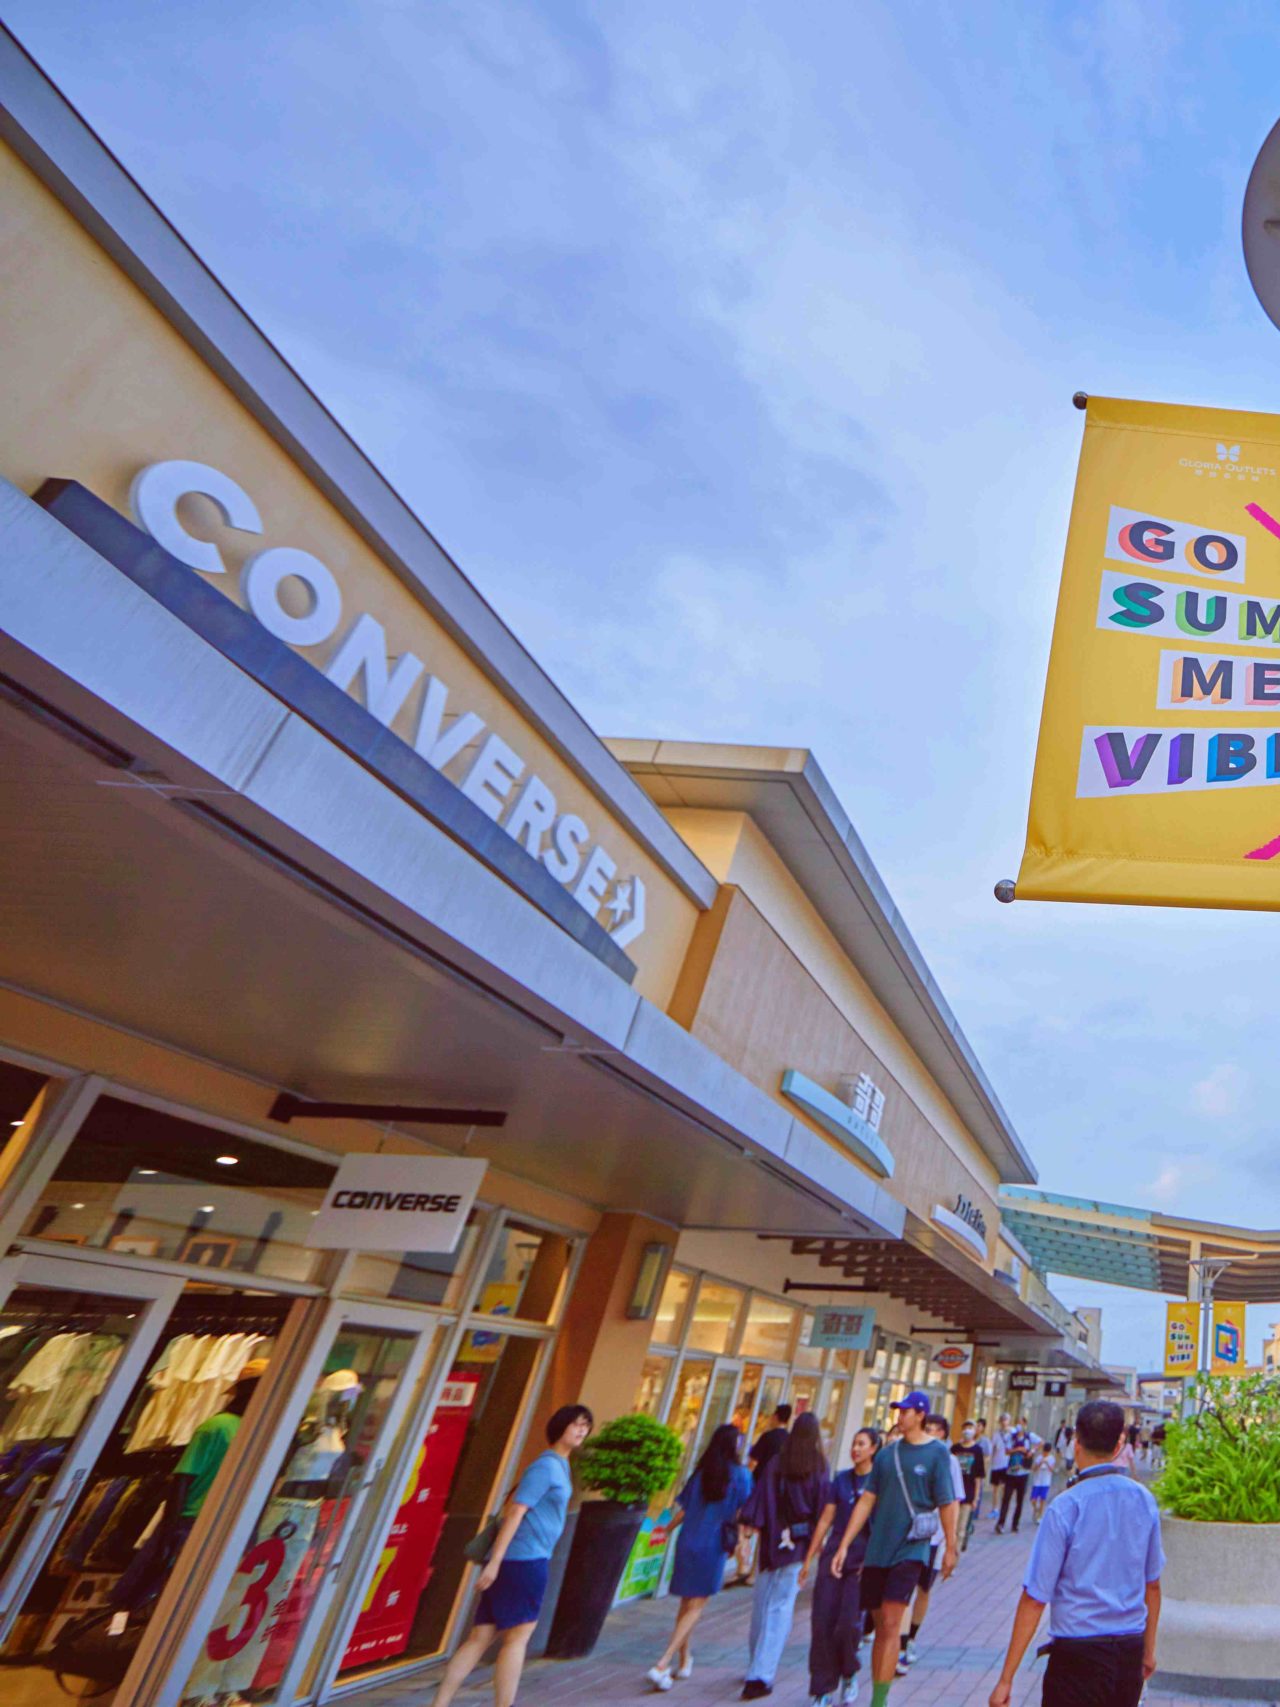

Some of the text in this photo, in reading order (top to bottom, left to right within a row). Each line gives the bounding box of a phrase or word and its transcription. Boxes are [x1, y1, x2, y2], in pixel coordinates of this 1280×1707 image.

[1118, 520, 1239, 575] GO
[129, 458, 618, 917] CONVERSE
[331, 1190, 462, 1213] CONVERSE
[206, 1537, 286, 1662] 3
